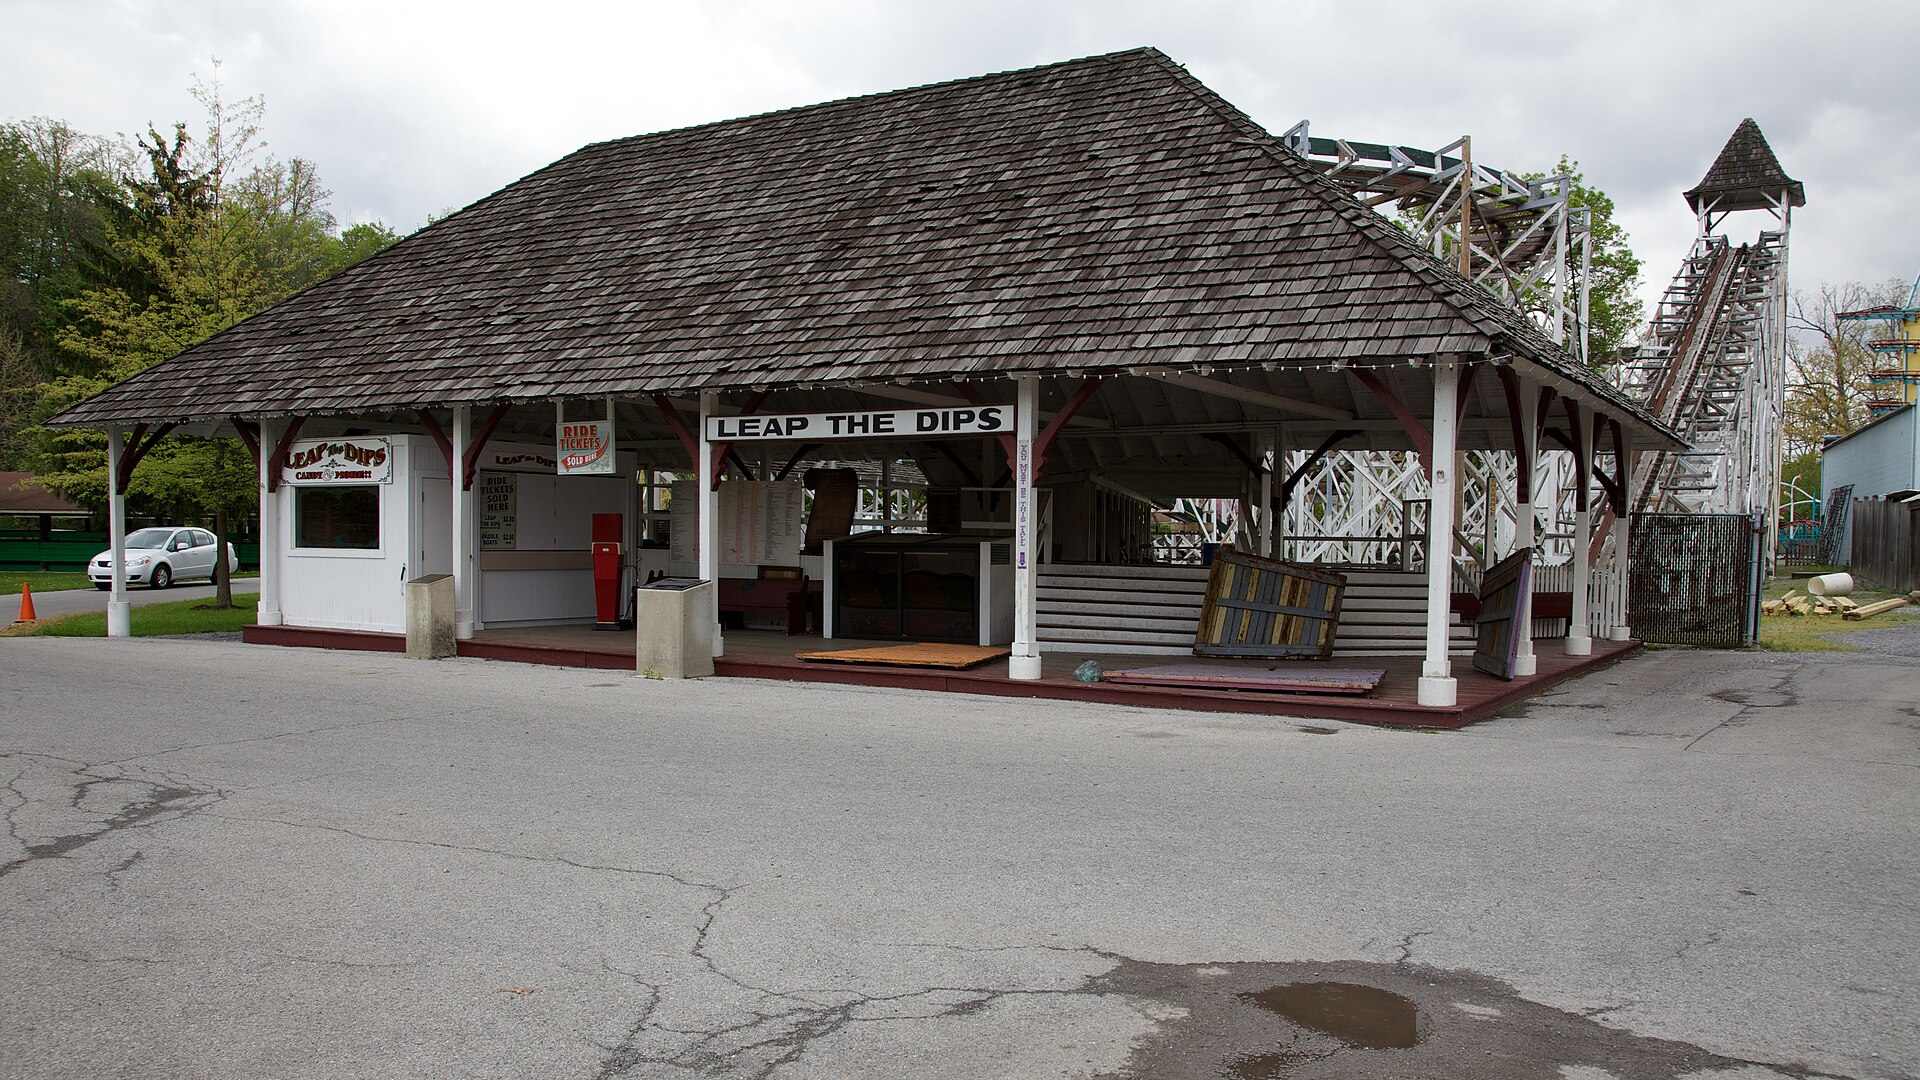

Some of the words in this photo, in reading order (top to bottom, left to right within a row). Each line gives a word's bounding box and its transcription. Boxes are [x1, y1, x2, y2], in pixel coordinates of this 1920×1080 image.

[717, 416, 809, 438] LEAP
[826, 413, 895, 435] THE
[916, 407, 1002, 431] DIPS
[563, 424, 598, 437] RIDE
[560, 437, 600, 450] TICKETS
[284, 442, 328, 470] LEAP
[326, 443, 344, 457] The
[344, 441, 387, 468] DIPS
[495, 454, 525, 465] LEAP
[566, 456, 583, 466] SOLD
[584, 452, 598, 463] HERE
[296, 471, 323, 480] CANDY
[322, 468, 334, 482] &
[1020, 464, 1028, 484] MUST
[487, 477, 508, 485] RIDE
[481, 485, 514, 494] TICKETS
[1020, 488, 1027, 498] BE
[487, 494, 509, 503] SOLD
[487, 502, 510, 511] HERE
